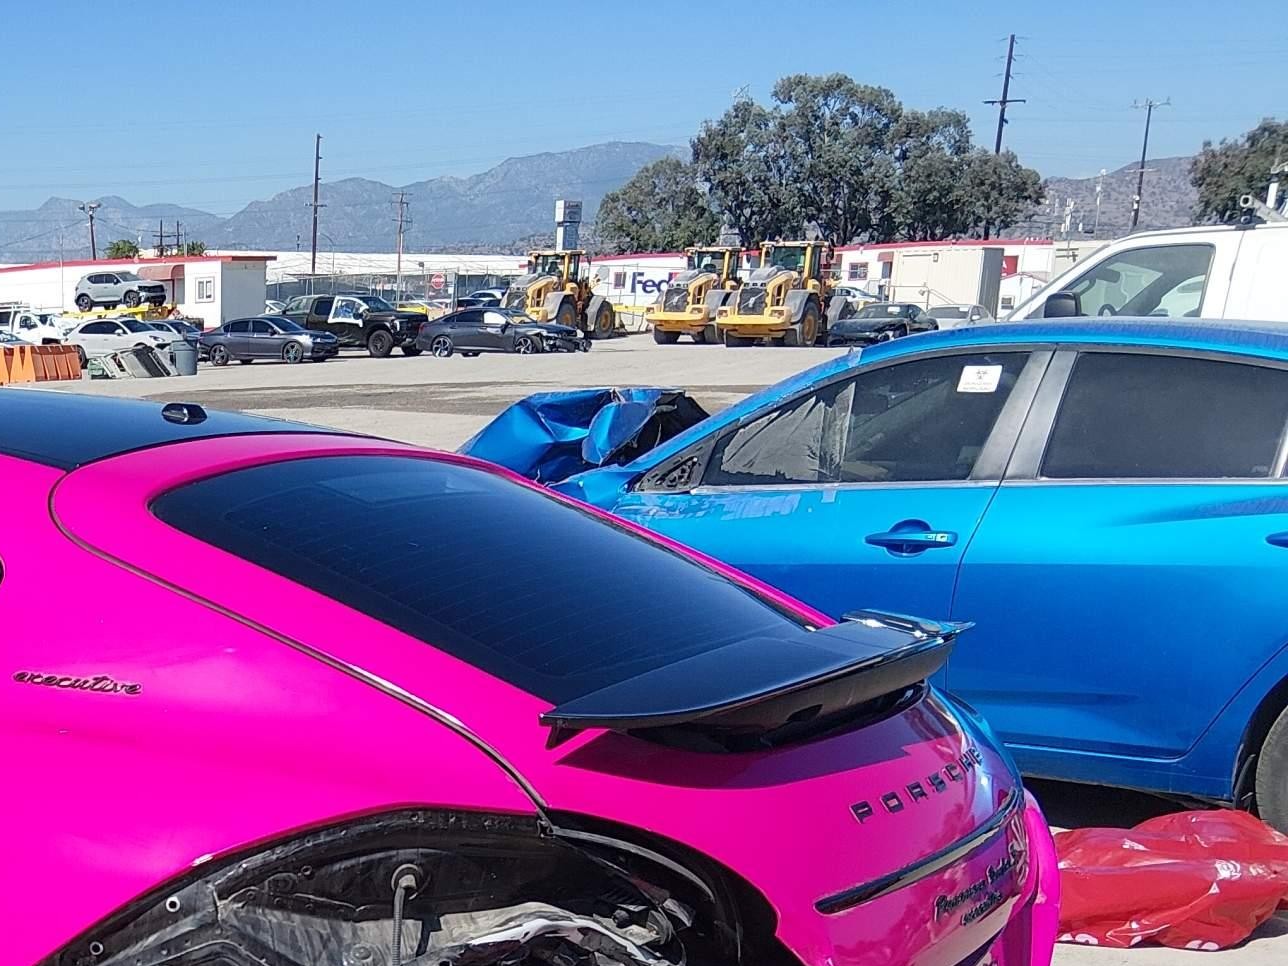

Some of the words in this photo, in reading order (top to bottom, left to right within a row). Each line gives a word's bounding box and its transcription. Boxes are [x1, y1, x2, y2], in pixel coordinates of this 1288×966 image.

[631, 272, 680, 294] Fed
[13, 671, 142, 695] executive
[849, 747, 983, 824] PORSCHE
